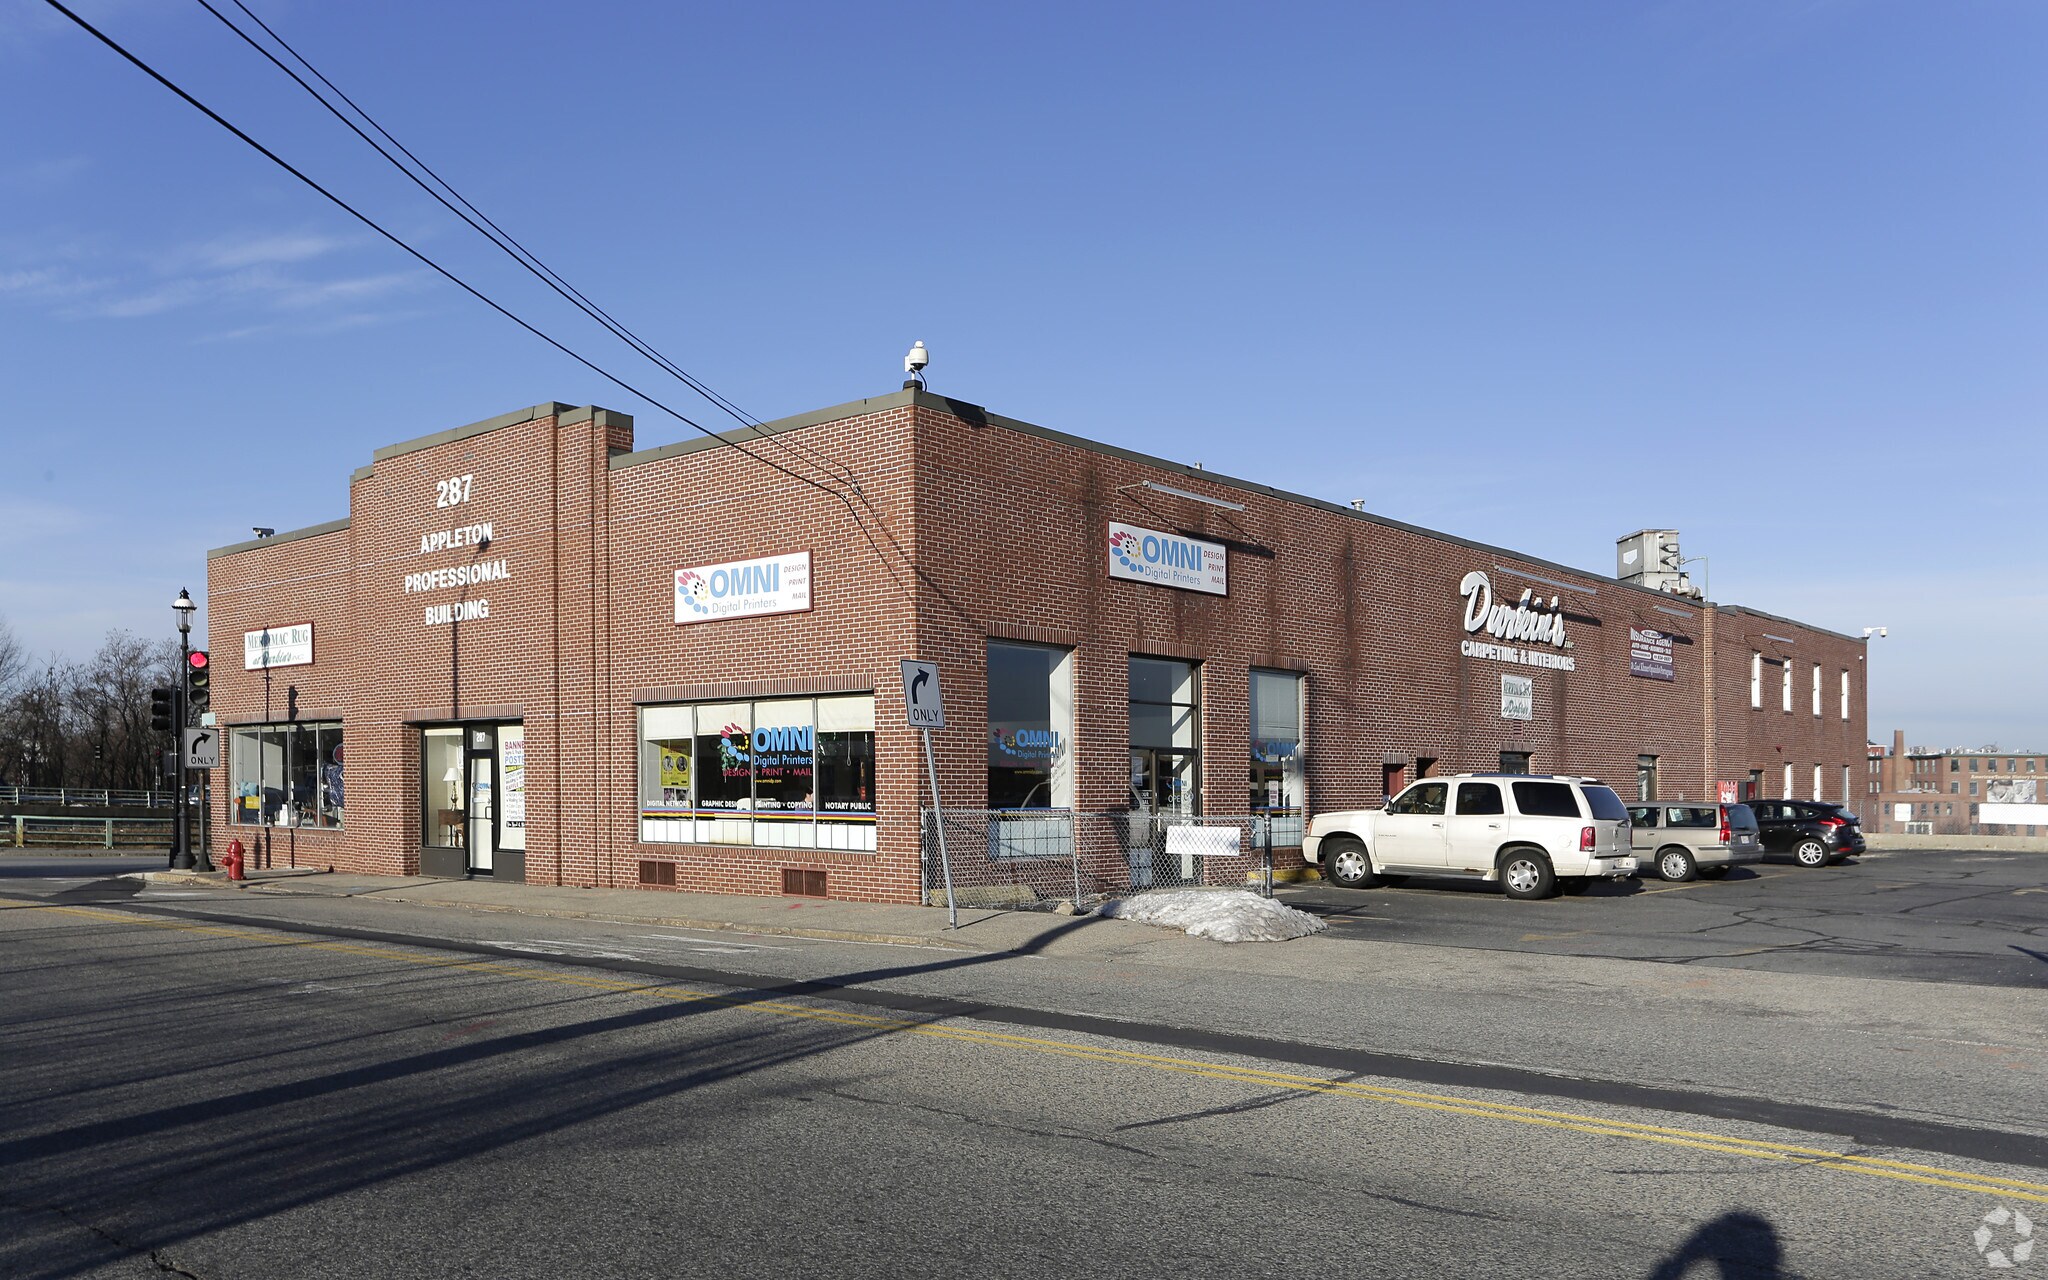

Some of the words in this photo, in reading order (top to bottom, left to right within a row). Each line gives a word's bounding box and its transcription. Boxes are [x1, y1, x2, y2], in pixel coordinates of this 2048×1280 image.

[436, 474, 474, 508] 287
[420, 522, 492, 554] APPLETON
[1142, 535, 1202, 572] OMNI
[1203, 550, 1224, 560] DESIGN
[784, 564, 806, 572] DESIGN
[1144, 566, 1170, 580] Digital
[1174, 570, 1200, 584] Printers
[1208, 563, 1224, 573] PRINT
[405, 560, 510, 593] PROFESSIONAL
[710, 562, 780, 598] OMNI
[788, 578, 806, 586] PRINT
[1210, 576, 1224, 585] MAIL
[792, 592, 806, 600] MAIL
[426, 599, 489, 626] BUILDING
[712, 601, 740, 616] Digital
[743, 598, 777, 611] Printers
[1460, 570, 1566, 647] Durkin's
[292, 628, 308, 644] RUG
[1460, 640, 1519, 664] CARPETING
[1520, 650, 1528, 664] &
[1528, 651, 1576, 672] INTERIORS
[912, 708, 939, 722] ONLY
[476, 732, 486, 742] 287
[752, 725, 814, 752] OMNI
[1015, 729, 1059, 748] OMNI
[190, 756, 216, 764] ONLY
[754, 754, 780, 768] Digital
[782, 754, 813, 766] Printers
[1018, 750, 1037, 760] Digital
[1038, 750, 1057, 759] Prin
[722, 768, 752, 776] DESIGN
[762, 768, 784, 776] PRINT
[792, 768, 812, 776] MAIL
[702, 800, 724, 808] GRAPHIC
[786, 801, 813, 809] COPYING
[825, 802, 848, 810] NOTARY
[850, 802, 872, 810] PUBLIC
